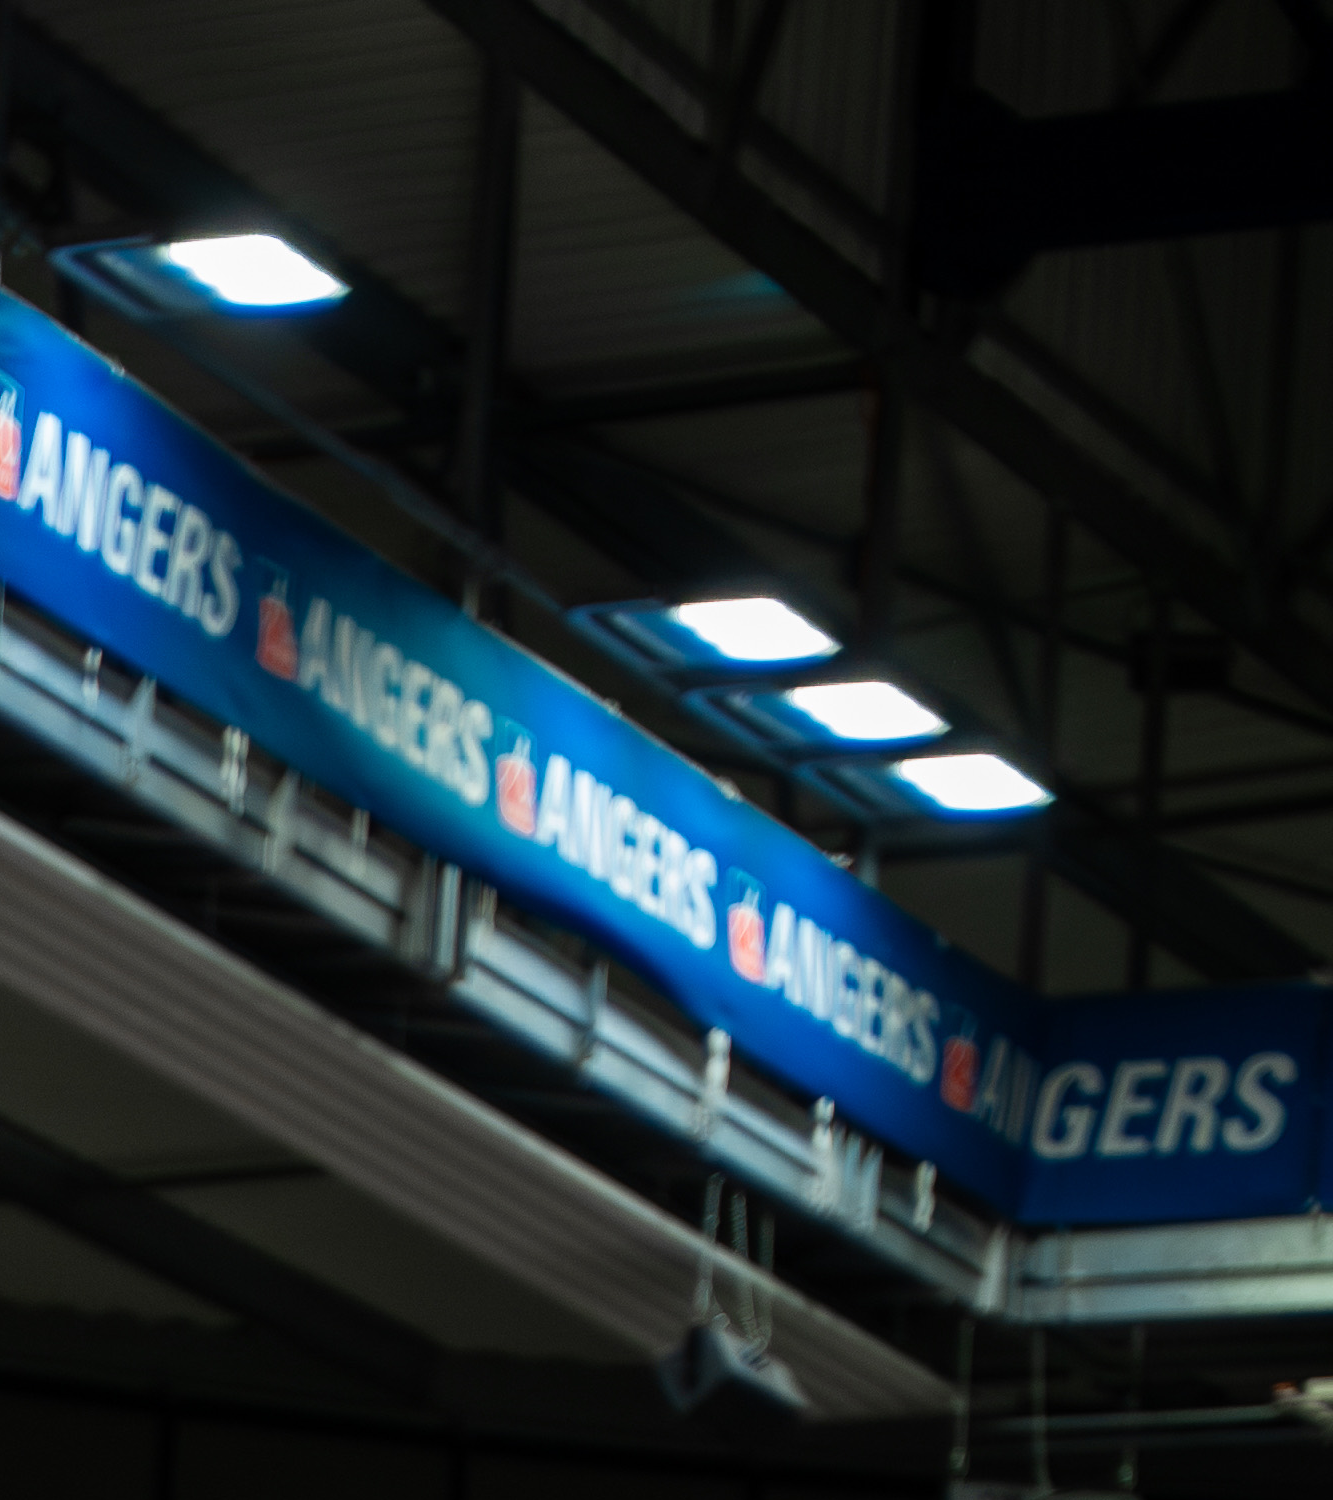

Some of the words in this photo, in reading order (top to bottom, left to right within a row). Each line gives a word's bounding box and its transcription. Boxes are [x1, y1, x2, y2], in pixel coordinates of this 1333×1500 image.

[16, 410, 243, 637] ANGERS
[296, 597, 494, 806] ANGERS
[534, 752, 719, 950] ANGERS
[764, 901, 941, 1084] ANGERS
